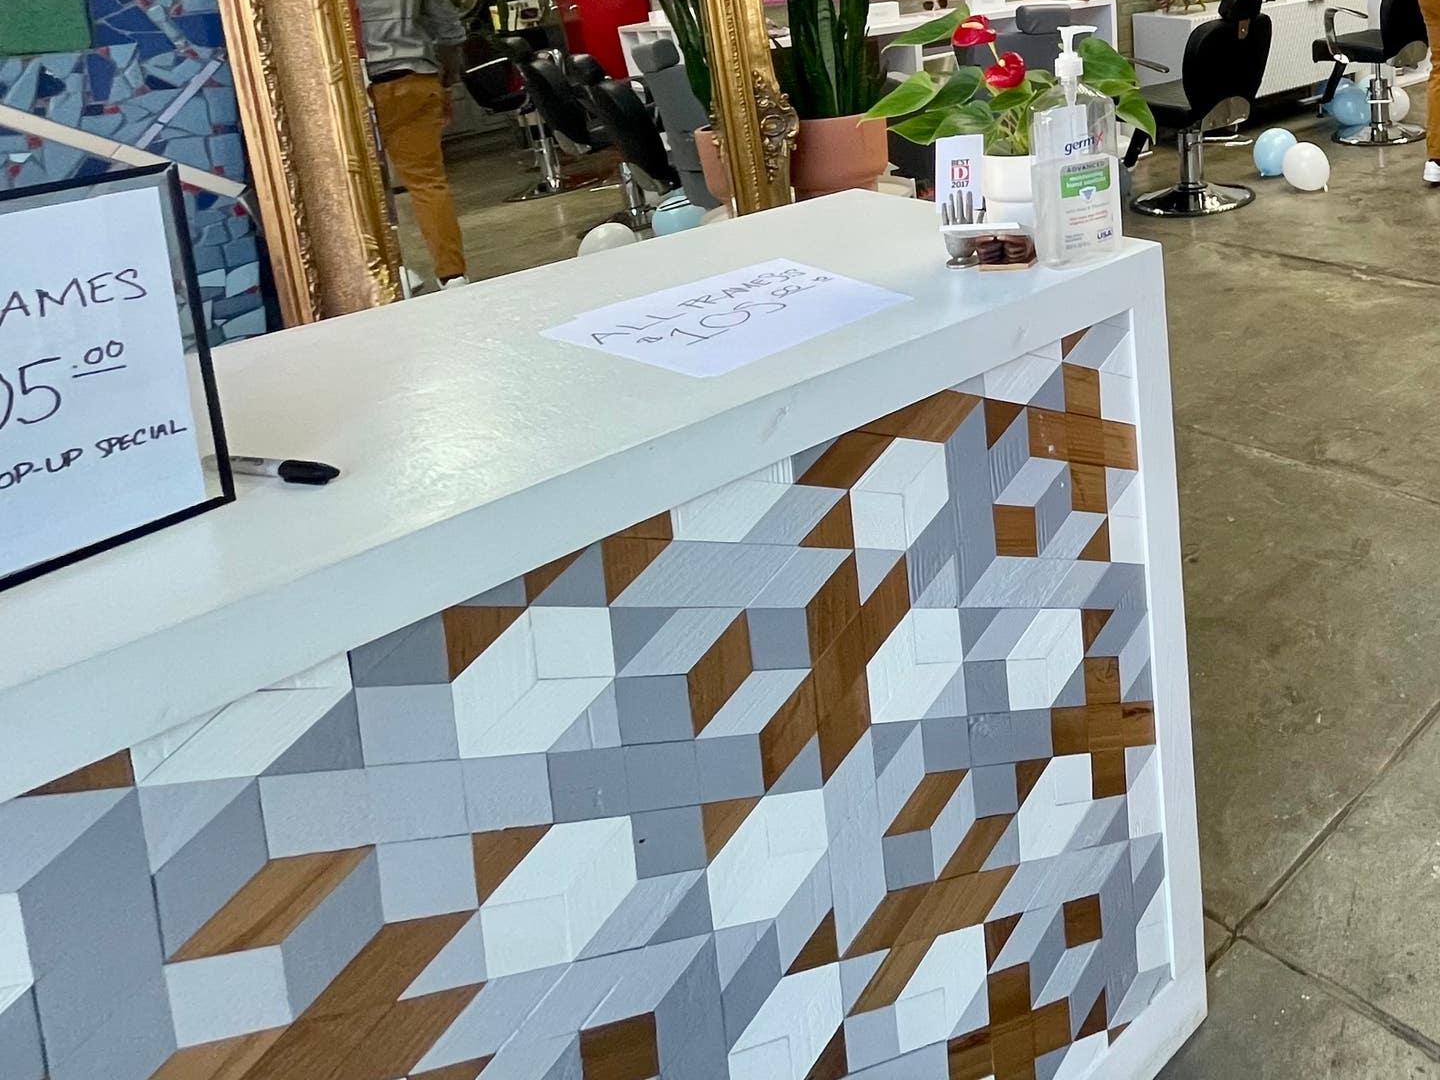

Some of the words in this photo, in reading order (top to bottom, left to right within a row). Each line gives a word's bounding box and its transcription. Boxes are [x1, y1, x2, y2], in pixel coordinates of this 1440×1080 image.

[951, 158, 970, 167] BEST
[951, 180, 970, 189] 2017
[1097, 229, 1112, 240] USA
[0, 268, 147, 326] AMES
[590, 312, 687, 345] ALL
[95, 419, 187, 458] SPECIAL
